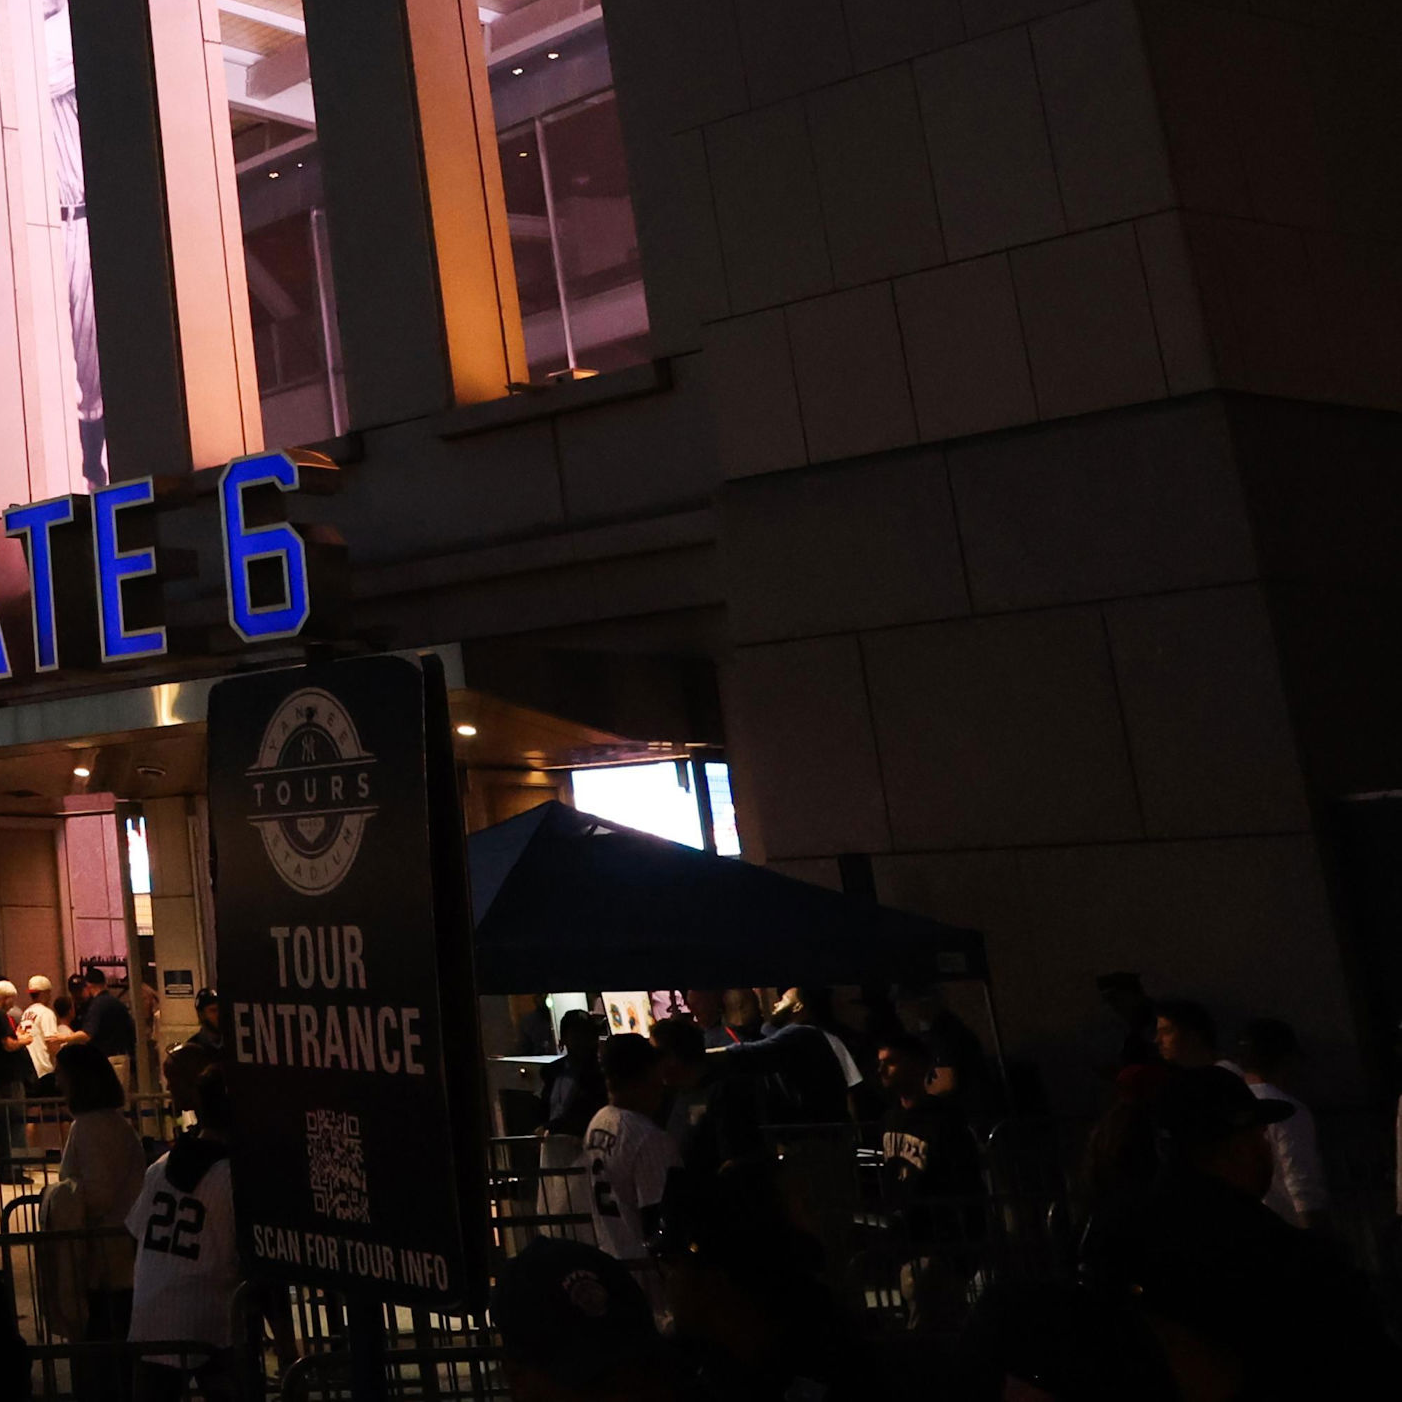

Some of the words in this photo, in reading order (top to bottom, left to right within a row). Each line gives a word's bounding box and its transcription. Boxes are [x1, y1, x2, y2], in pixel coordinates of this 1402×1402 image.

[218, 449, 311, 644] 6
[253, 772, 371, 807] TOURS
[270, 827, 354, 882] STADIUM
[269, 924, 368, 990] TOUR
[231, 1002, 426, 1075] ENTRANCE
[145, 1191, 205, 1260] 22
[252, 1222, 301, 1265] SCAN
[304, 1232, 341, 1271] FOR
[345, 1239, 396, 1282] TOUR
[400, 1248, 449, 1293] INFO
